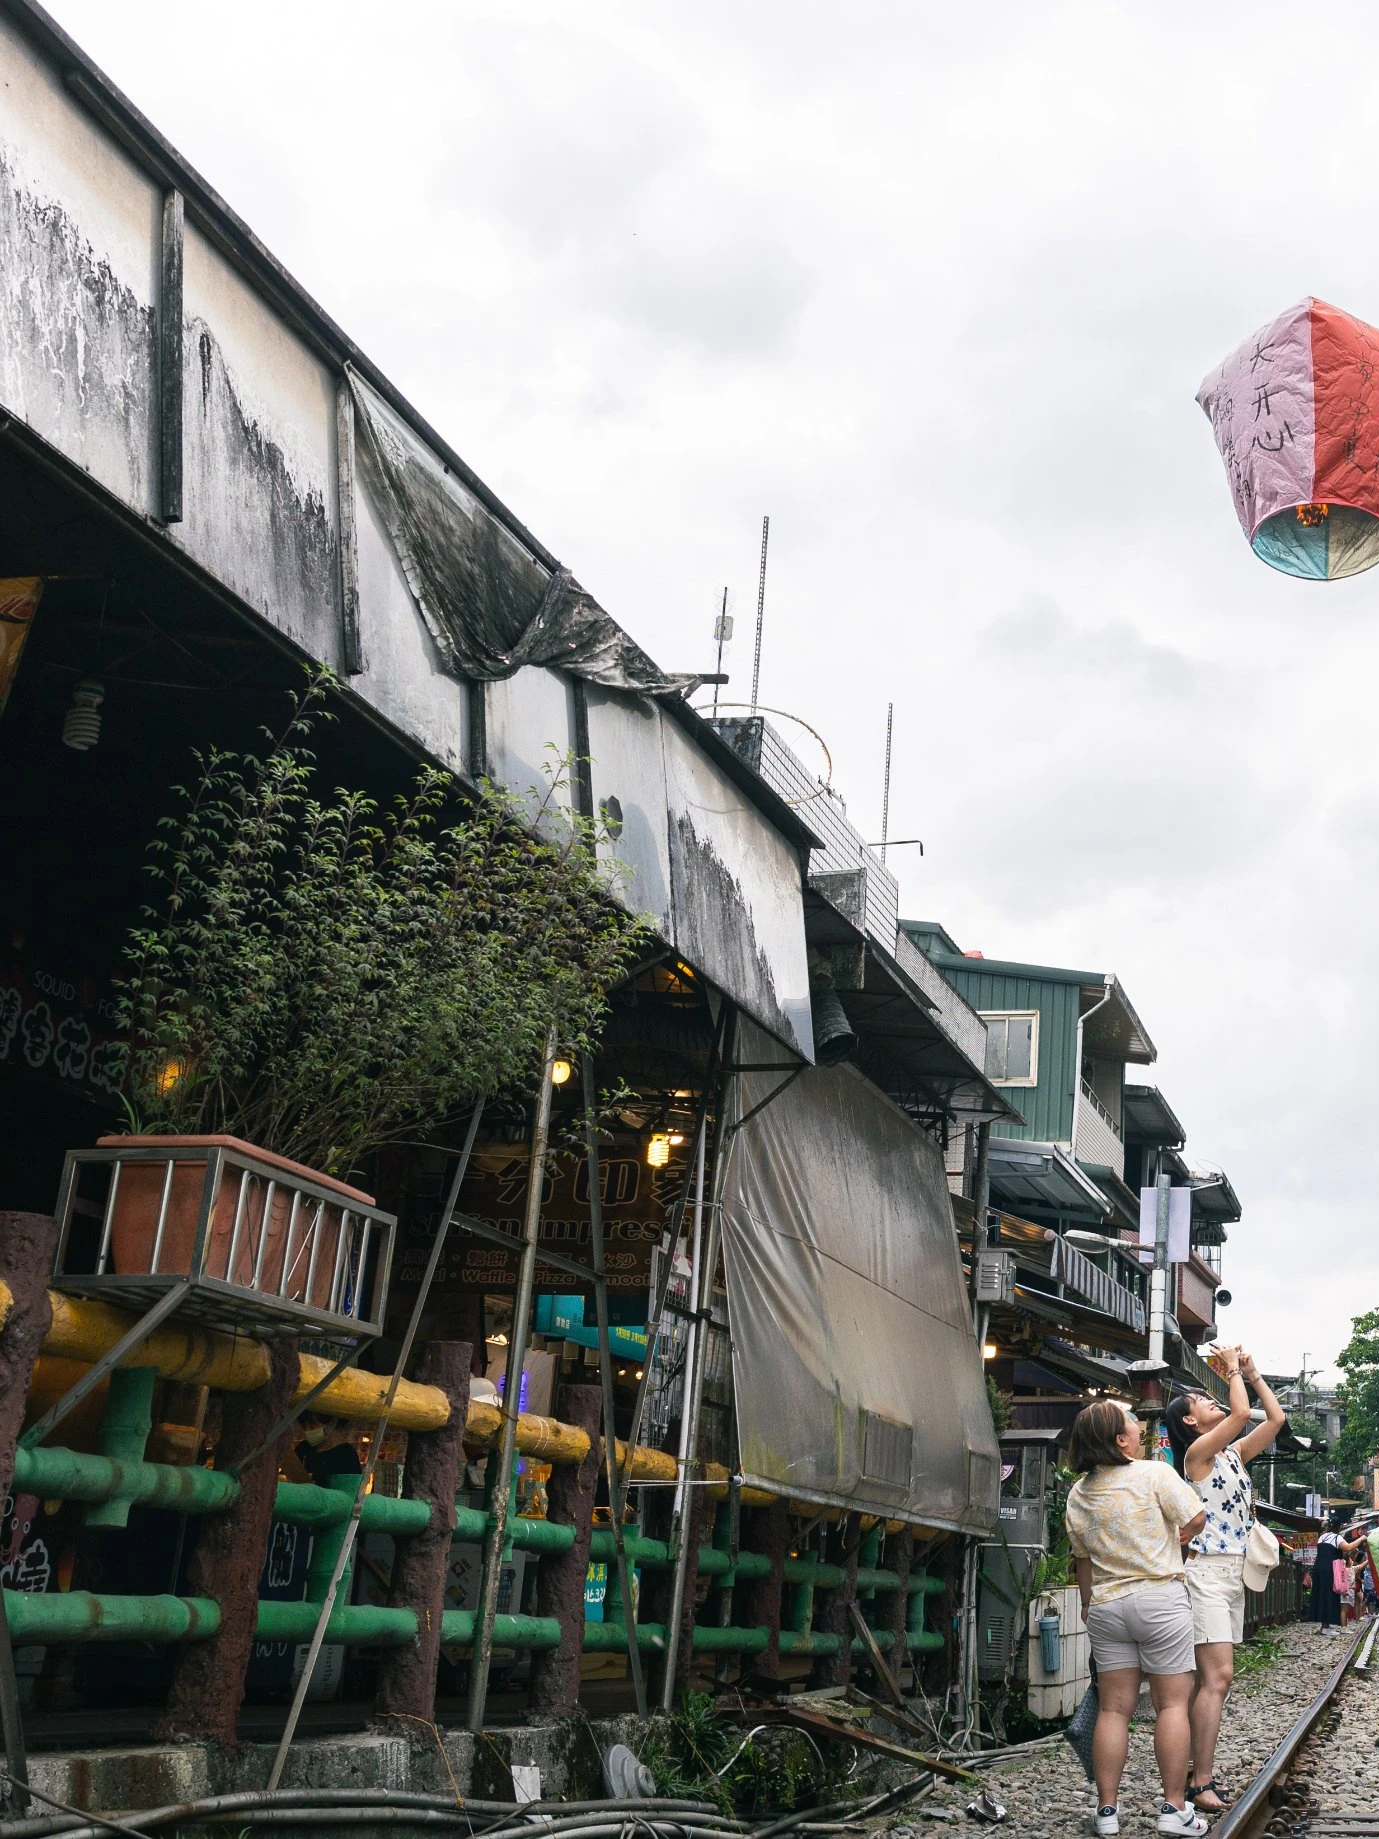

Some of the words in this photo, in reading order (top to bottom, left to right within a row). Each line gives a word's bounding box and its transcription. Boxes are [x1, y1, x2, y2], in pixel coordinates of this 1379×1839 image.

[32, 970, 75, 1001] SQUID
[462, 1269, 516, 1284] Waffle
[533, 1271, 576, 1285] Pizza
